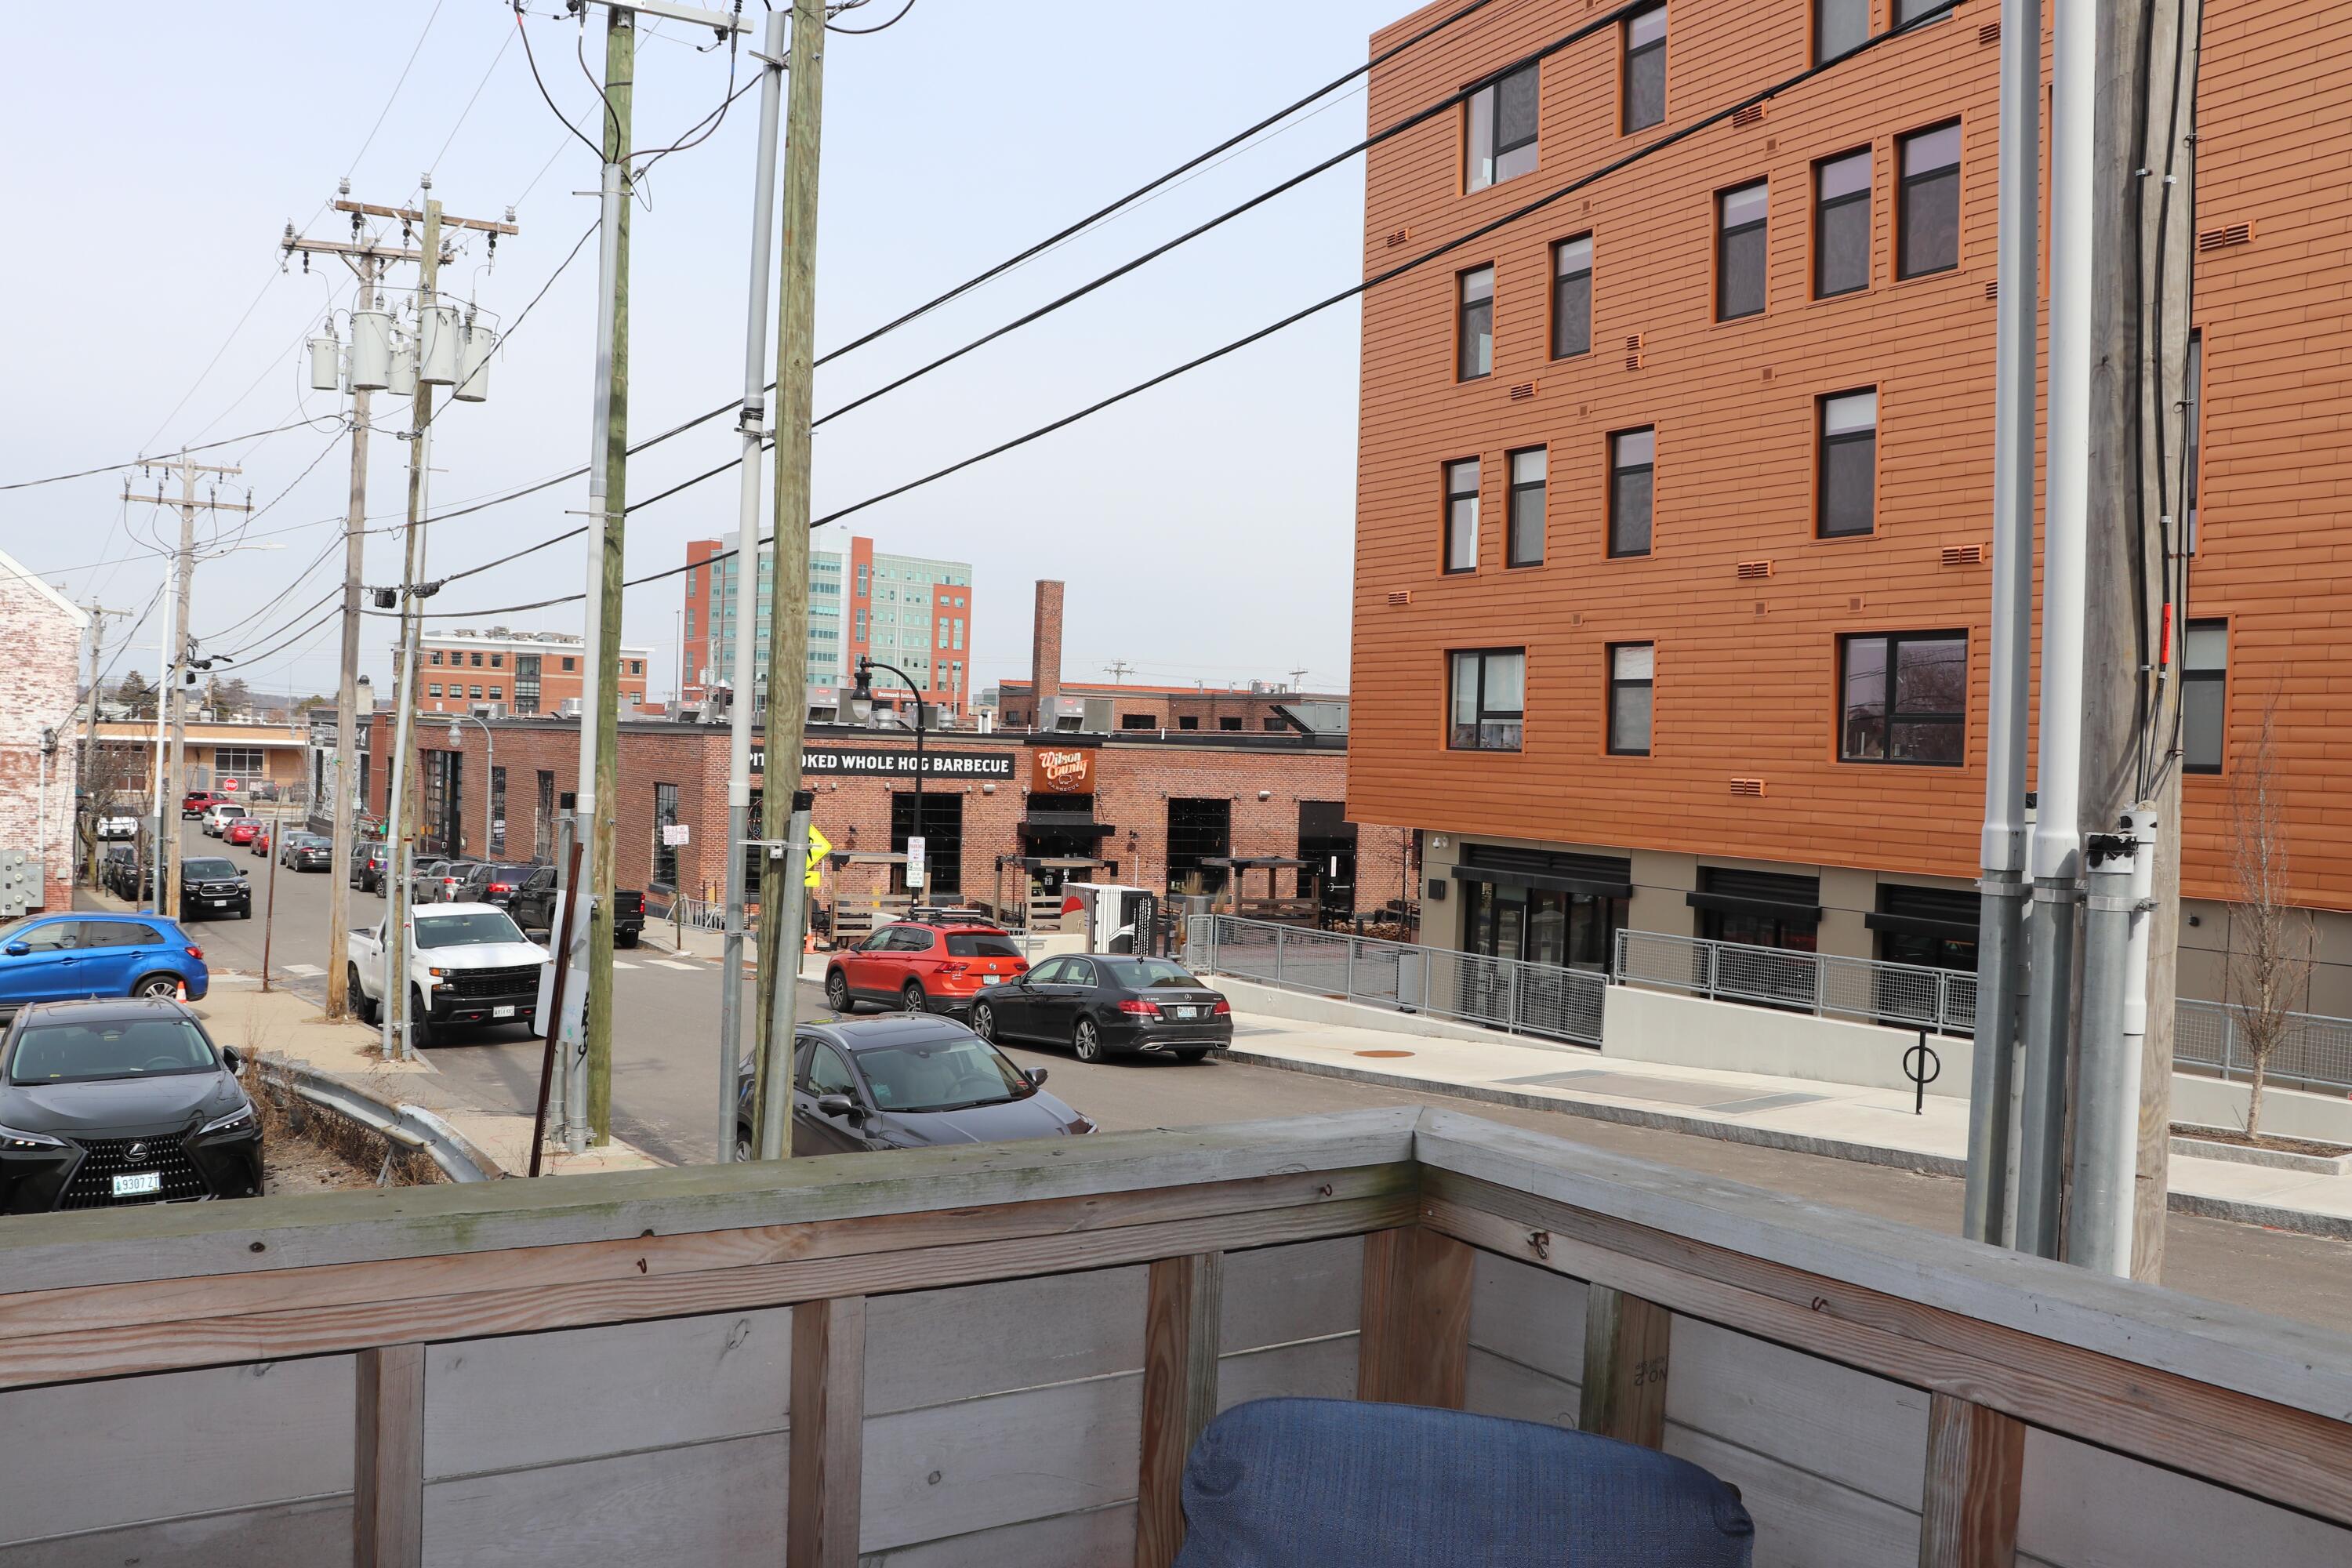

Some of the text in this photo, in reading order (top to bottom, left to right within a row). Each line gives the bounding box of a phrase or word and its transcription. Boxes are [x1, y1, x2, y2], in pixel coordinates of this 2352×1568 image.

[840, 756, 894, 770] WHOLE
[898, 757, 929, 771] HOG
[933, 757, 1010, 773] BARBECUE
[1038, 751, 1081, 768] Wilson
[1046, 759, 1089, 780] County
[1047, 781, 1080, 792] BARBECUE
[122, 1178, 145, 1190] 9307
